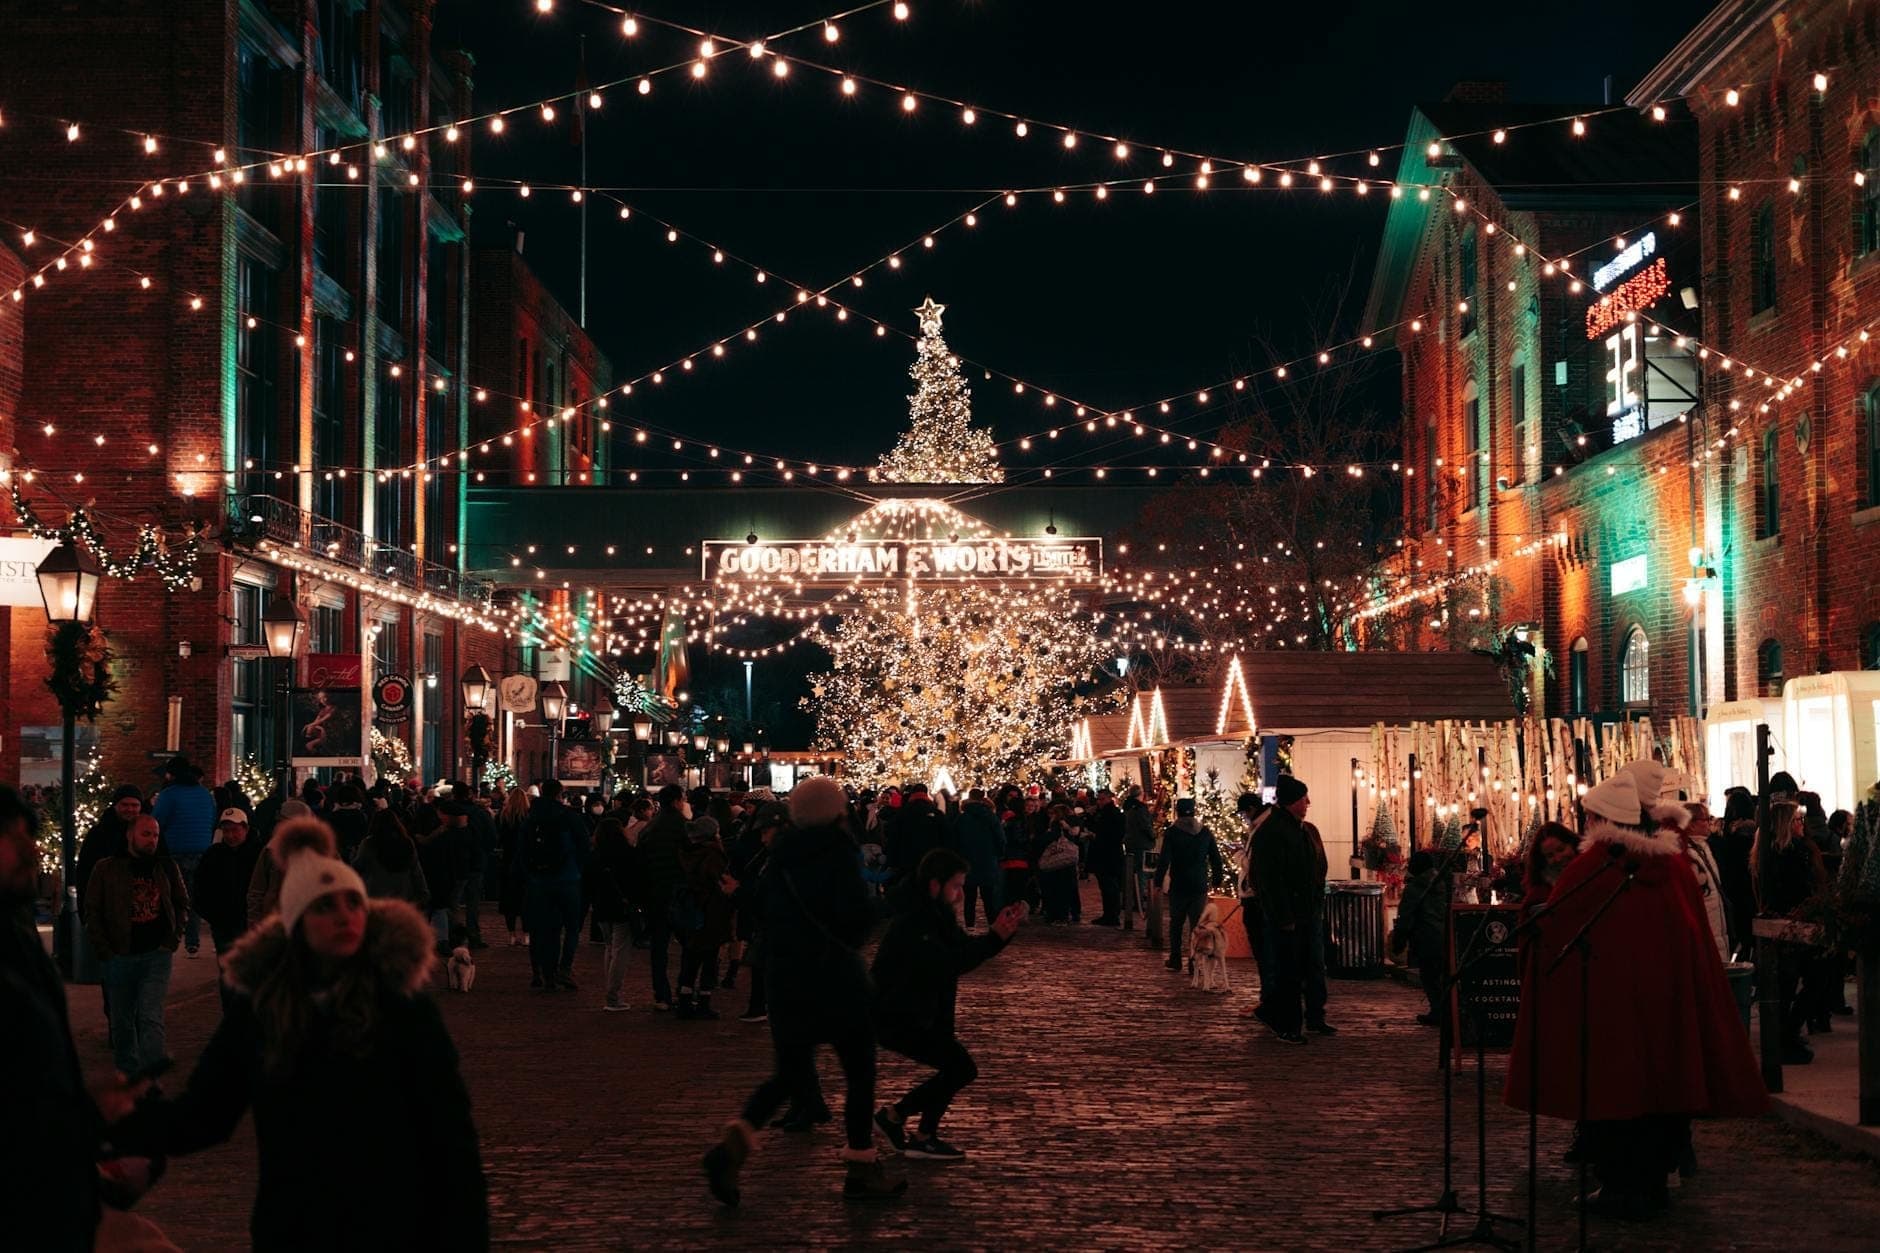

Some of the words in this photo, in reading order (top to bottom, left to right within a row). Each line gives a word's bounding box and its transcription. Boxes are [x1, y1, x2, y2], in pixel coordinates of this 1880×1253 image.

[719, 546, 898, 574] GOODERHAM
[932, 546, 1031, 572] WORTS
[1481, 978, 1521, 986] ASTINGS
[1474, 995, 1521, 1003] COCKTAIL
[1487, 1012, 1517, 1020] TOURS
